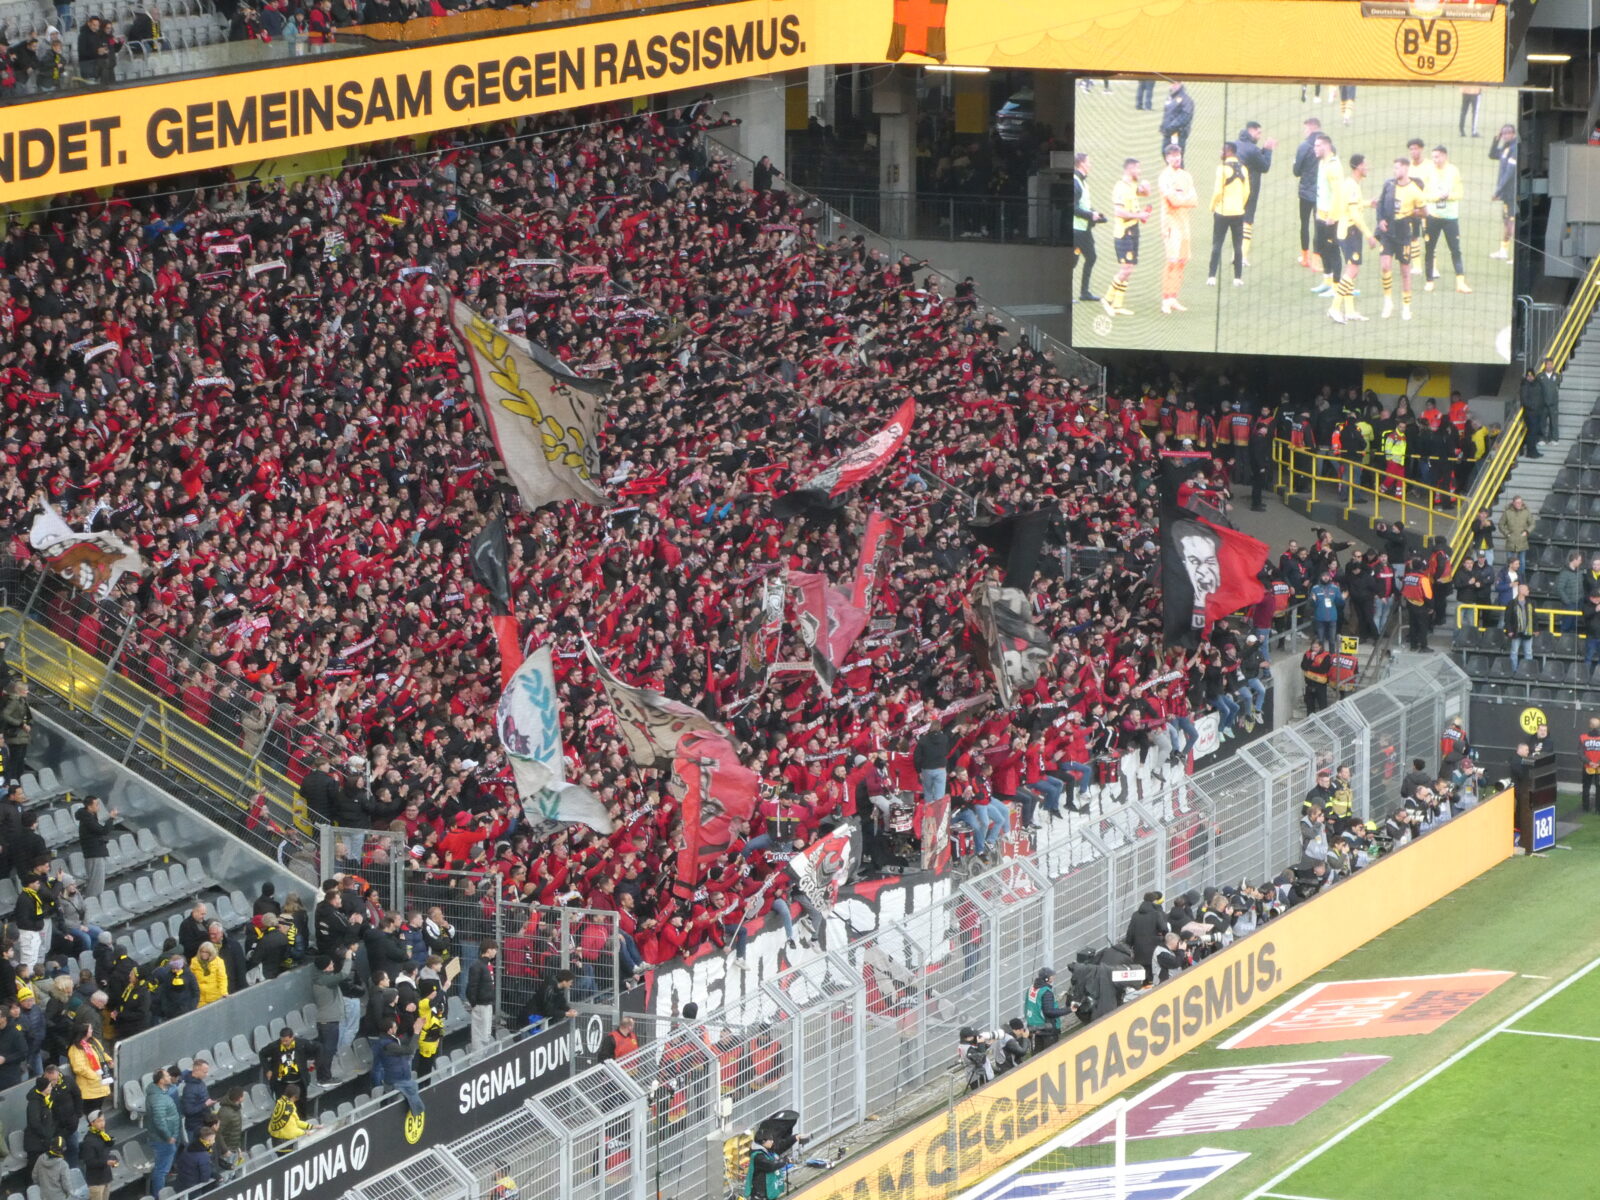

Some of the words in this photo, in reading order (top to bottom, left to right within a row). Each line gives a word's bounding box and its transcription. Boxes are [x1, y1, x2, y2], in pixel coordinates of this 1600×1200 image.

[1404, 18, 1452, 55] BVB
[1417, 56, 1436, 69] 09
[146, 70, 432, 159] GEMEINSAM
[444, 47, 586, 111] GEGEN
[594, 14, 807, 88] RASSISMUS.
[1524, 711, 1543, 726] BVB
[1535, 815, 1553, 840] 1&1
[458, 1057, 527, 1114] SIGNAL
[529, 1027, 584, 1081] IDUNA
[925, 1062, 1067, 1188] GEGEN
[1075, 941, 1282, 1101] RASSISMUS.
[284, 1143, 348, 1200] IDUNA
